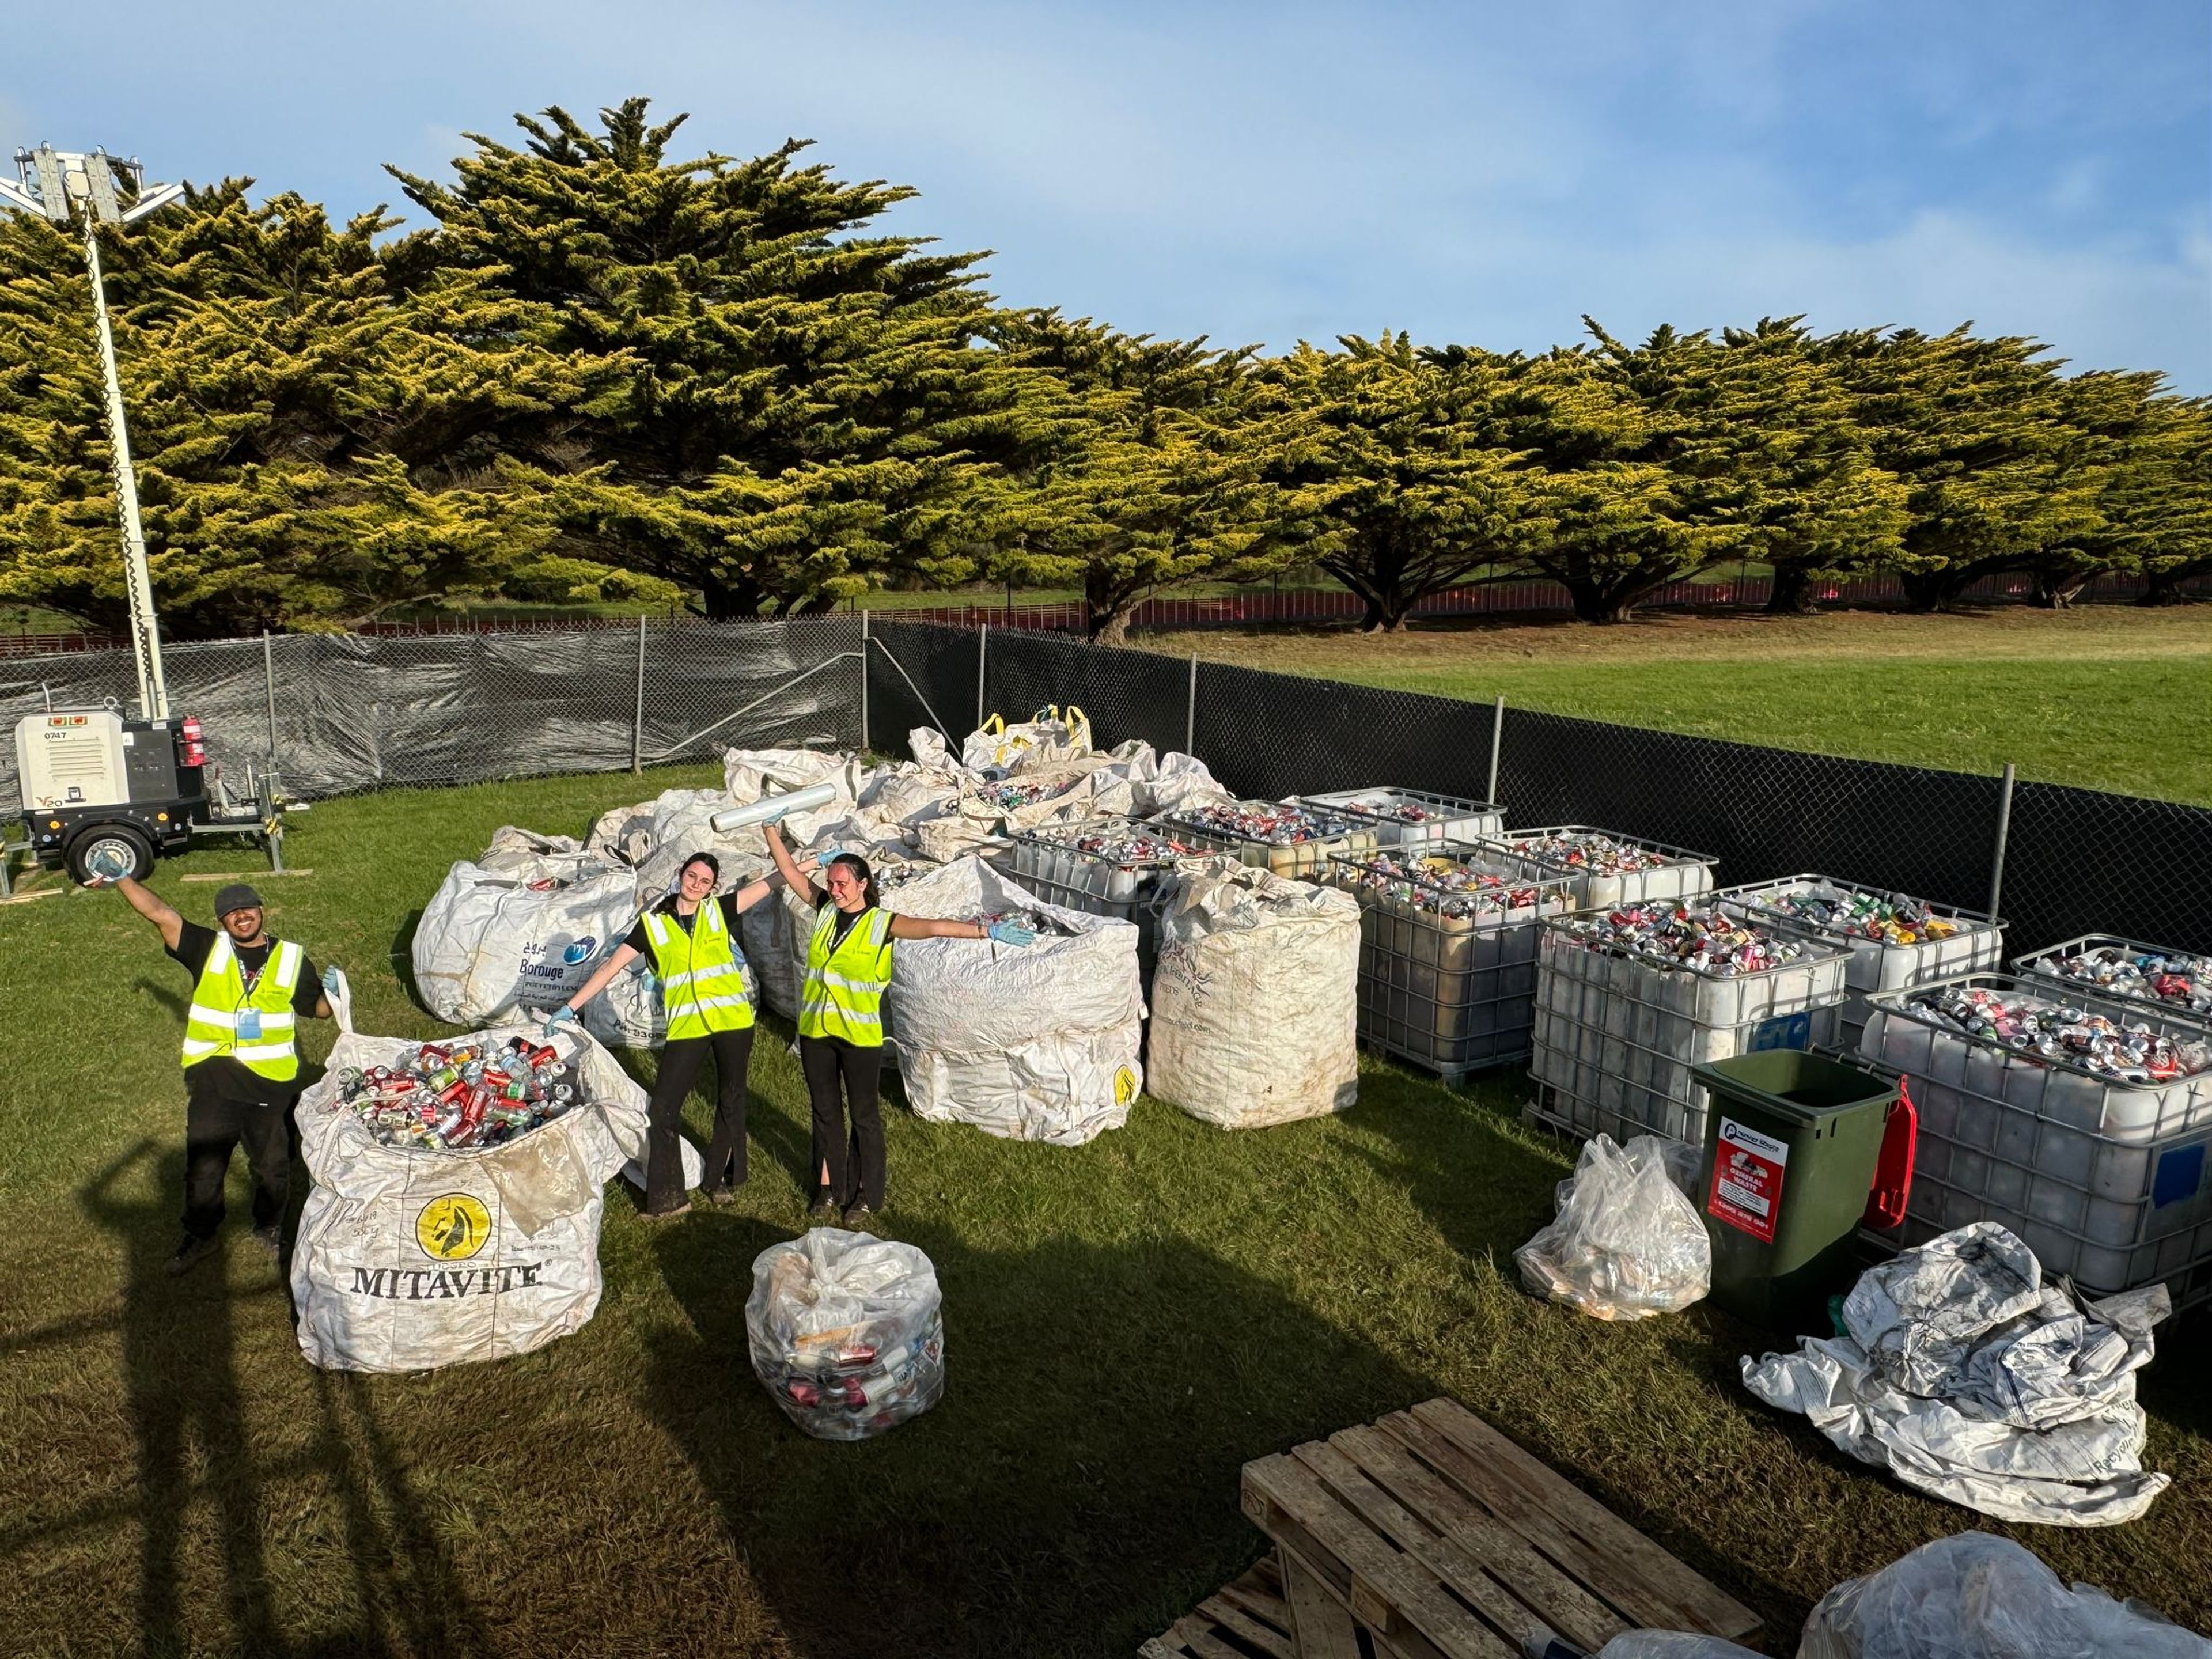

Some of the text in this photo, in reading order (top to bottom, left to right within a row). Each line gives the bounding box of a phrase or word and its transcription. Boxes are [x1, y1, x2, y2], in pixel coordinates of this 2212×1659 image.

[520, 959, 564, 980] Borouge
[1734, 1175, 1758, 1192] WASTE
[350, 1262, 543, 1300] MITAVITE
